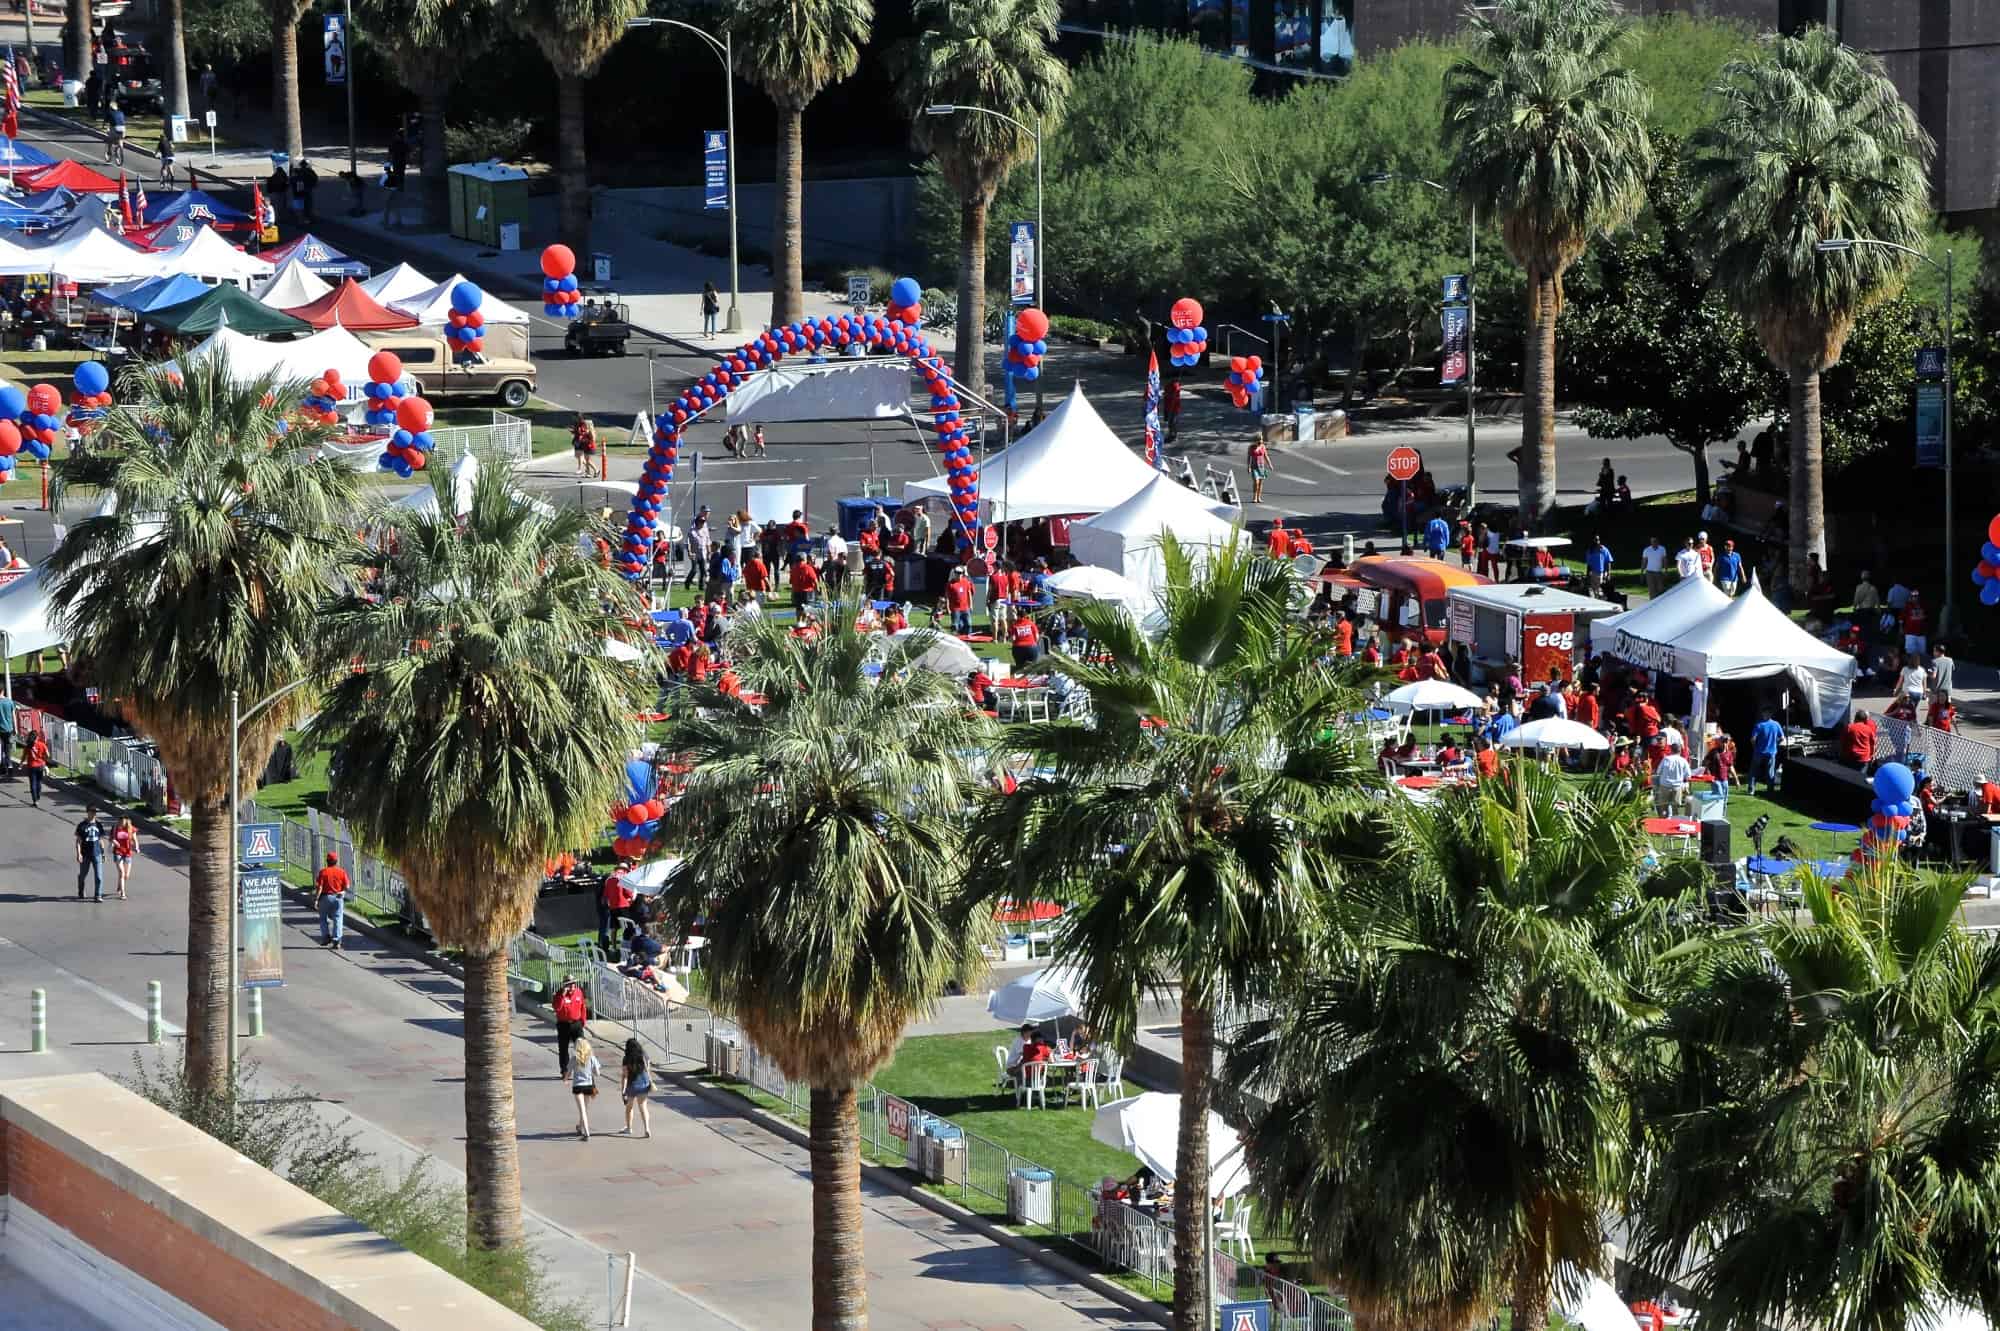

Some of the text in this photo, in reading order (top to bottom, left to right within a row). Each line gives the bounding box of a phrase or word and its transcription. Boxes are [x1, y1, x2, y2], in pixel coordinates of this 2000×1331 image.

[851, 290, 868, 302] 20
[1446, 358, 1454, 374] THE
[1390, 456, 1417, 470] STOP
[1535, 631, 1574, 651] eeg
[247, 830, 275, 857] A
[244, 877, 279, 888] WE ARE
